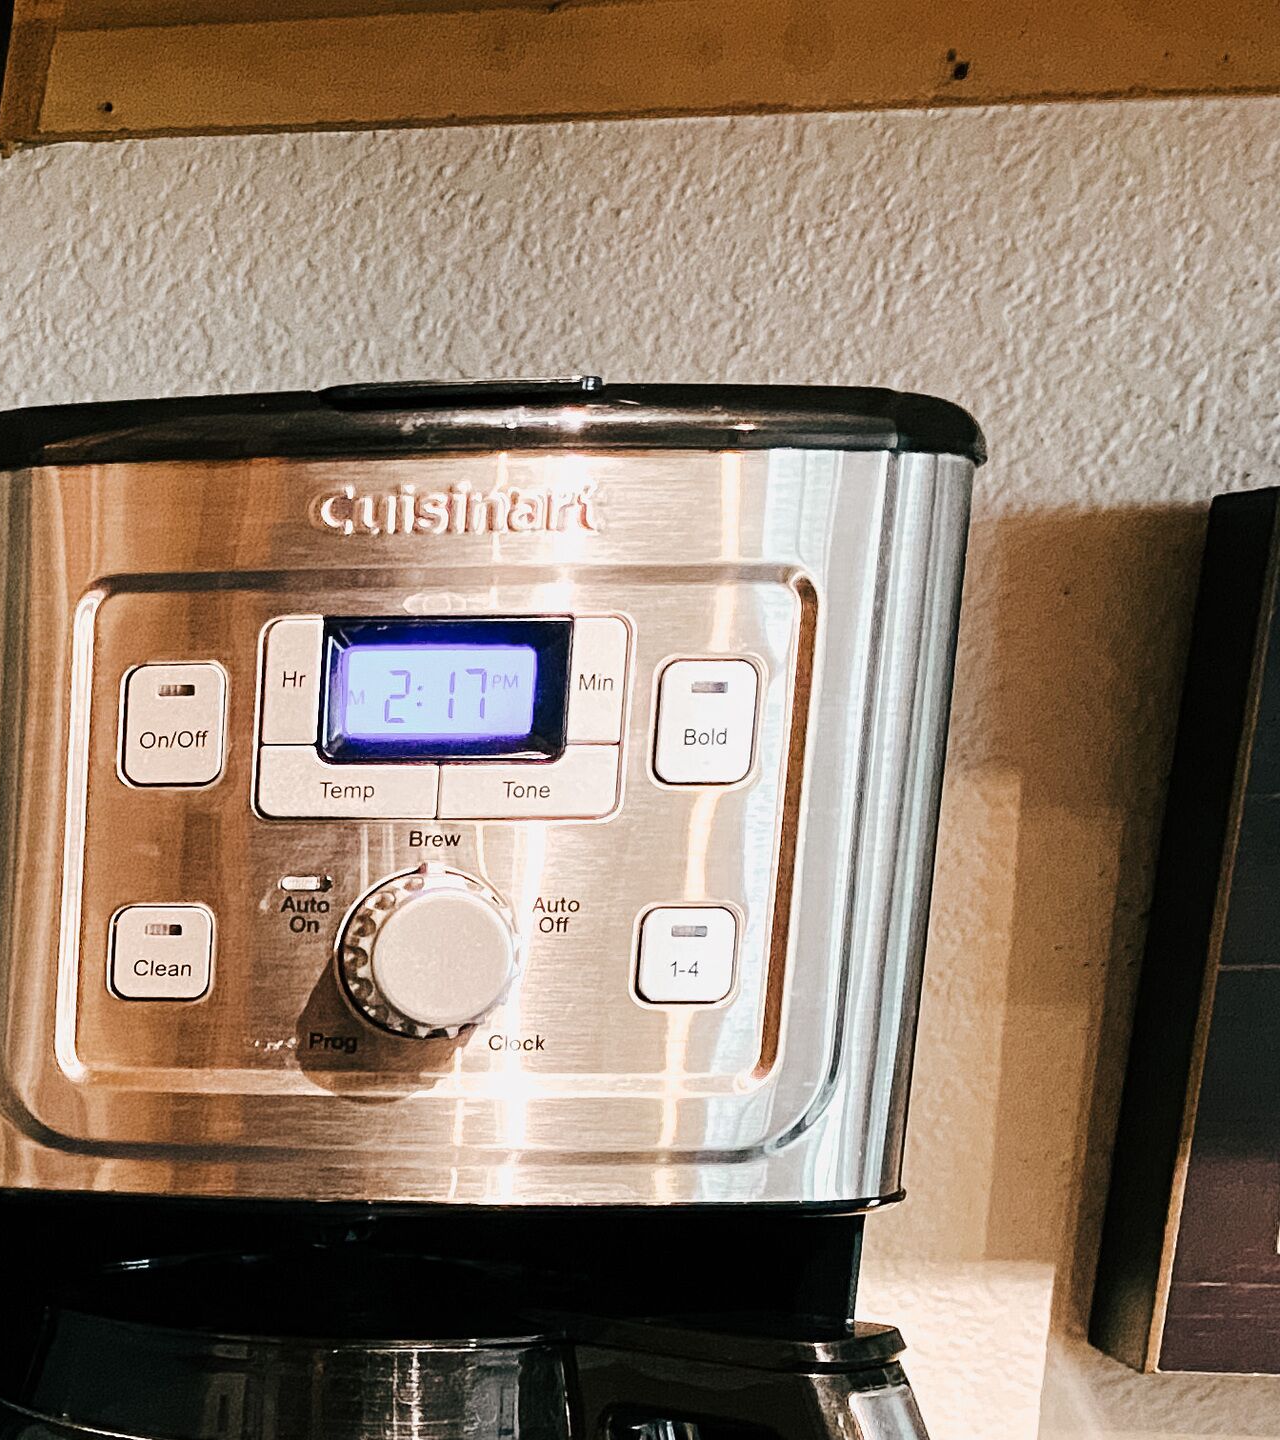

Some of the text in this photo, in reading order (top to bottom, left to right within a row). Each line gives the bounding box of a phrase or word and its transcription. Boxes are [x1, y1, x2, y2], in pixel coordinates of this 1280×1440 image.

[312, 480, 600, 536] Cuisinart
[282, 670, 307, 689] Hr
[578, 672, 615, 692] Min
[384, 668, 488, 724] 2:17
[491, 673, 520, 691] PM
[139, 730, 209, 749] On/Off
[683, 728, 728, 747] Bold
[319, 781, 376, 803] Temp
[502, 781, 552, 800] Tone
[408, 830, 462, 848] Brew
[280, 896, 331, 914] Auto
[532, 896, 581, 914] Auto
[290, 916, 321, 934] On
[538, 916, 571, 934] Off
[132, 959, 192, 977] Clean
[670, 960, 700, 978] 1-4
[308, 1031, 359, 1054] Prog
[488, 1033, 546, 1052] Clock
